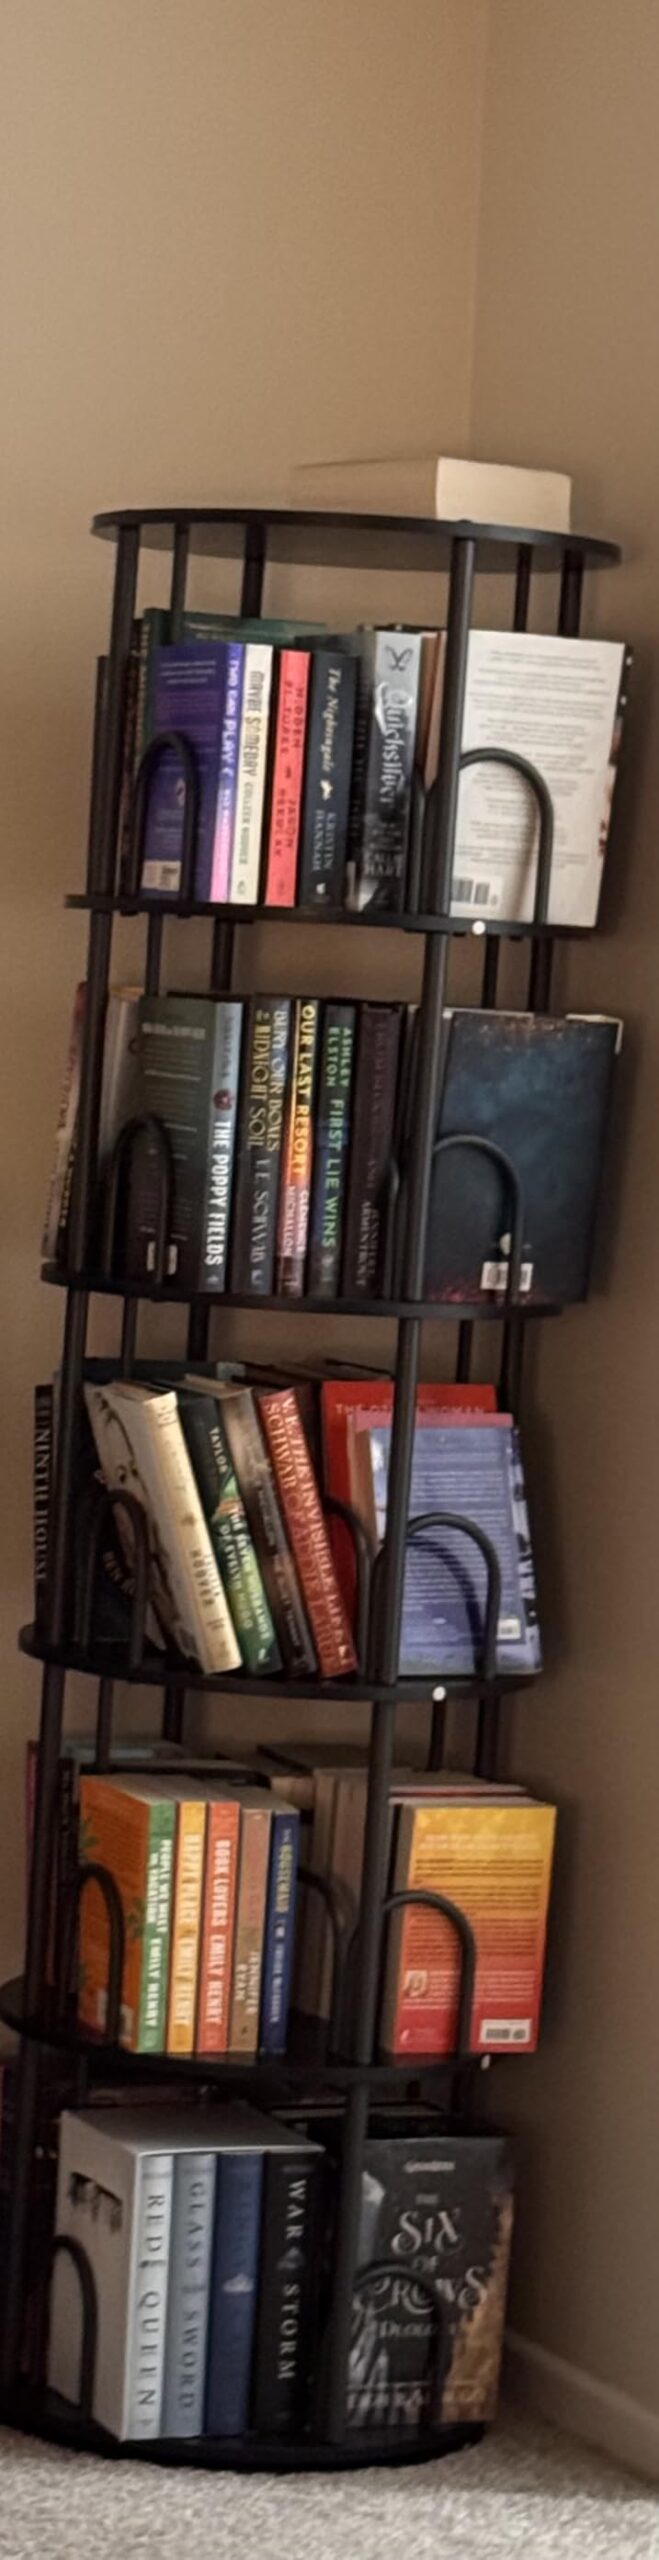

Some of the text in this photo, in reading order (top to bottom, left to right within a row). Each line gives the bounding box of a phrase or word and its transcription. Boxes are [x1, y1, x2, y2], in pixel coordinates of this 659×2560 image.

[222, 718, 237, 764] PLAY
[244, 670, 266, 778] MAYBE SOMEDAY
[321, 667, 341, 772] The Nightingale
[376, 681, 415, 805] Quicksilver
[313, 808, 325, 872] HANNAH
[251, 1024, 270, 1099] MIDNIGHT
[268, 1009, 289, 1152] BURY OUR BONES
[293, 1004, 317, 1176] OUR LAST RESORT
[327, 1026, 340, 1087] ELSTON
[342, 1027, 352, 1088] ASHLEY
[249, 1107, 265, 1149] SOIL
[206, 1120, 231, 1266] THE POPPY FIELDS
[322, 1099, 344, 1248] FIRST LIE WINS
[251, 1190, 271, 1264] SCHWAB
[208, 1426, 229, 1474] TAYLOR
[264, 1403, 297, 1488] SCHWAB
[229, 1504, 247, 1533] THE
[235, 1532, 255, 1573] SEVEN
[291, 1437, 345, 1643] THE INVISIBLE LIFE
[222, 1541, 244, 1590] EVELYN
[147, 1867, 159, 1924] VACATION
[157, 1839, 173, 1933] PEOPLE WE MEET
[212, 1839, 231, 1927] BOOK LOVERS
[146, 1938, 162, 2027] EMILY HENRY
[206, 1934, 226, 2026] EMILY HENRY
[235, 1963, 248, 2000] RYAN
[138, 2193, 166, 2407] RED QUEEN
[178, 2181, 205, 2409] GLASS SWORD
[276, 2179, 307, 2380] WAR STORM
